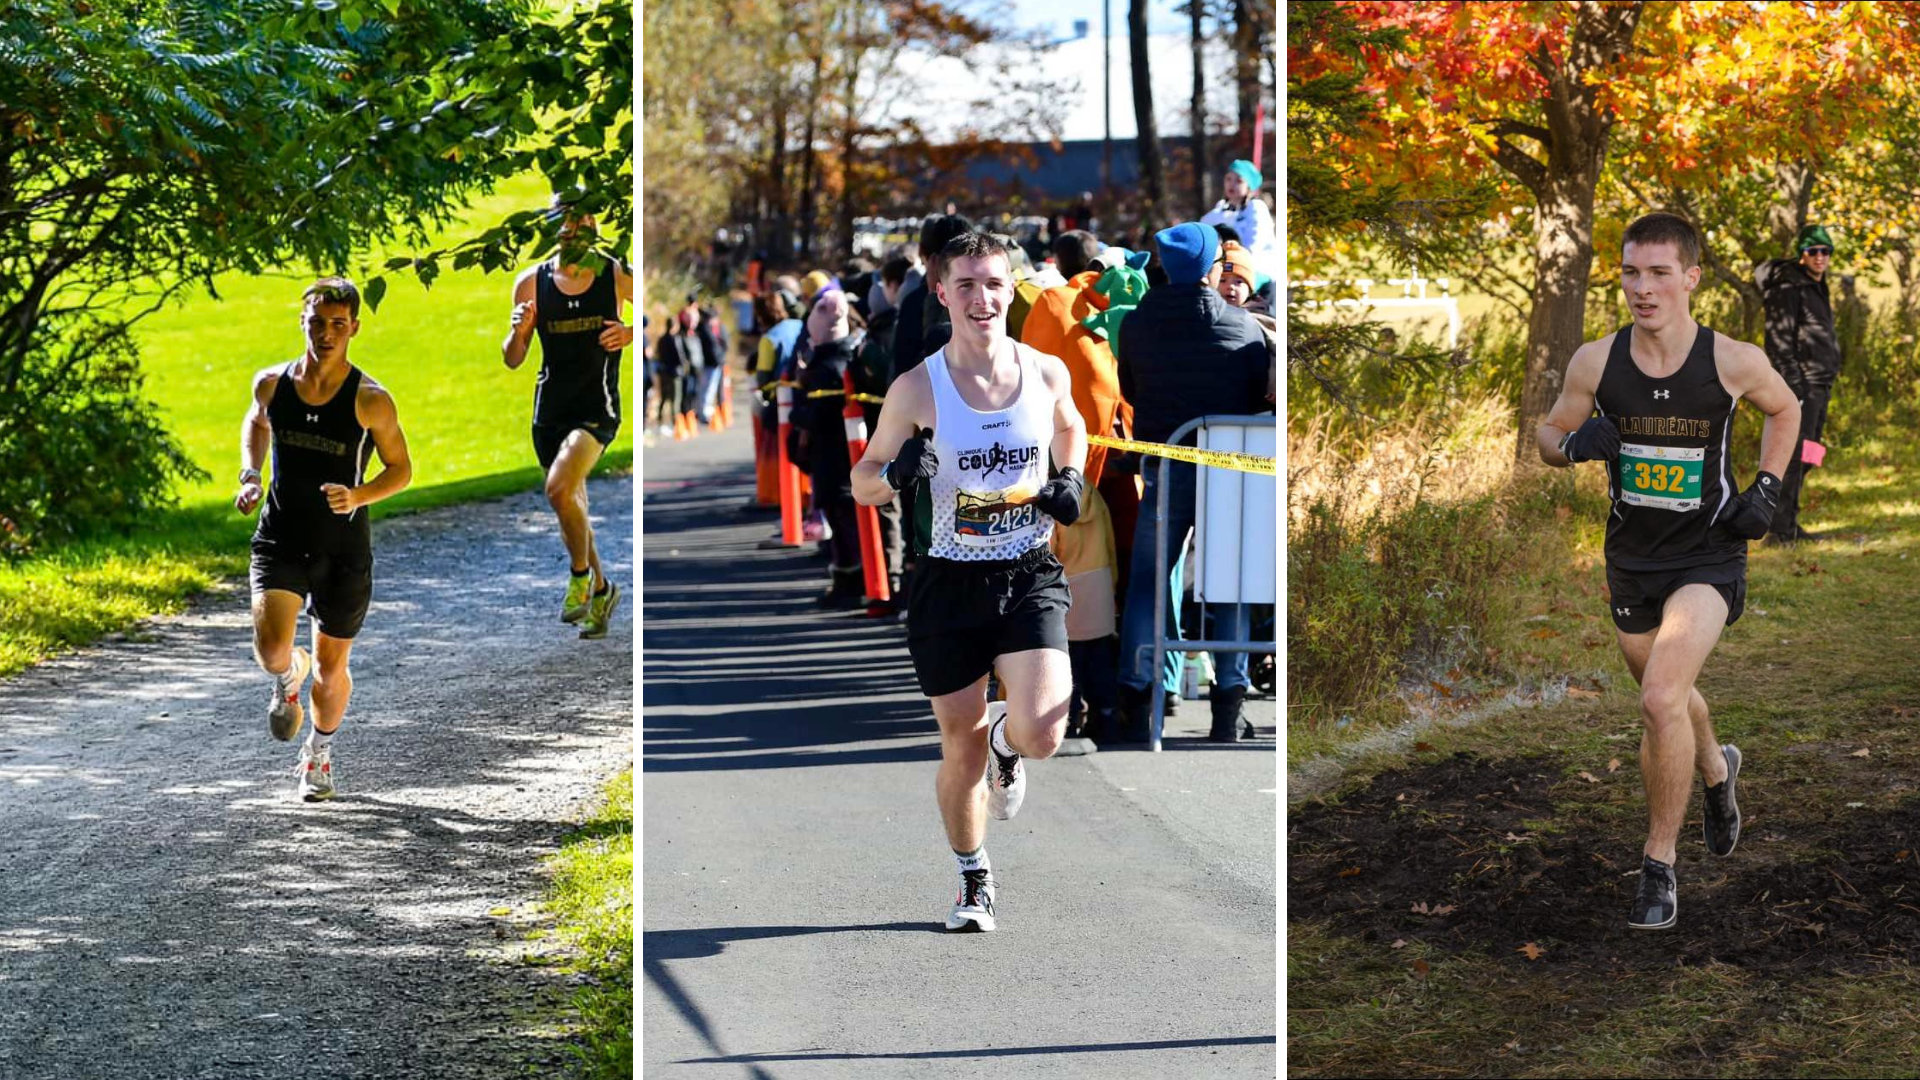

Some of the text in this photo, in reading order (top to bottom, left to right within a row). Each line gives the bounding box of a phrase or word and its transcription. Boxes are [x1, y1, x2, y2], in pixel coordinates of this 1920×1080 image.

[982, 421, 1006, 431] CRAFT
[1620, 416, 1710, 438] LAURÉATS
[957, 447, 982, 456] CLINIQUE
[1635, 462, 1685, 493] 332
[988, 504, 1032, 535] 2423
